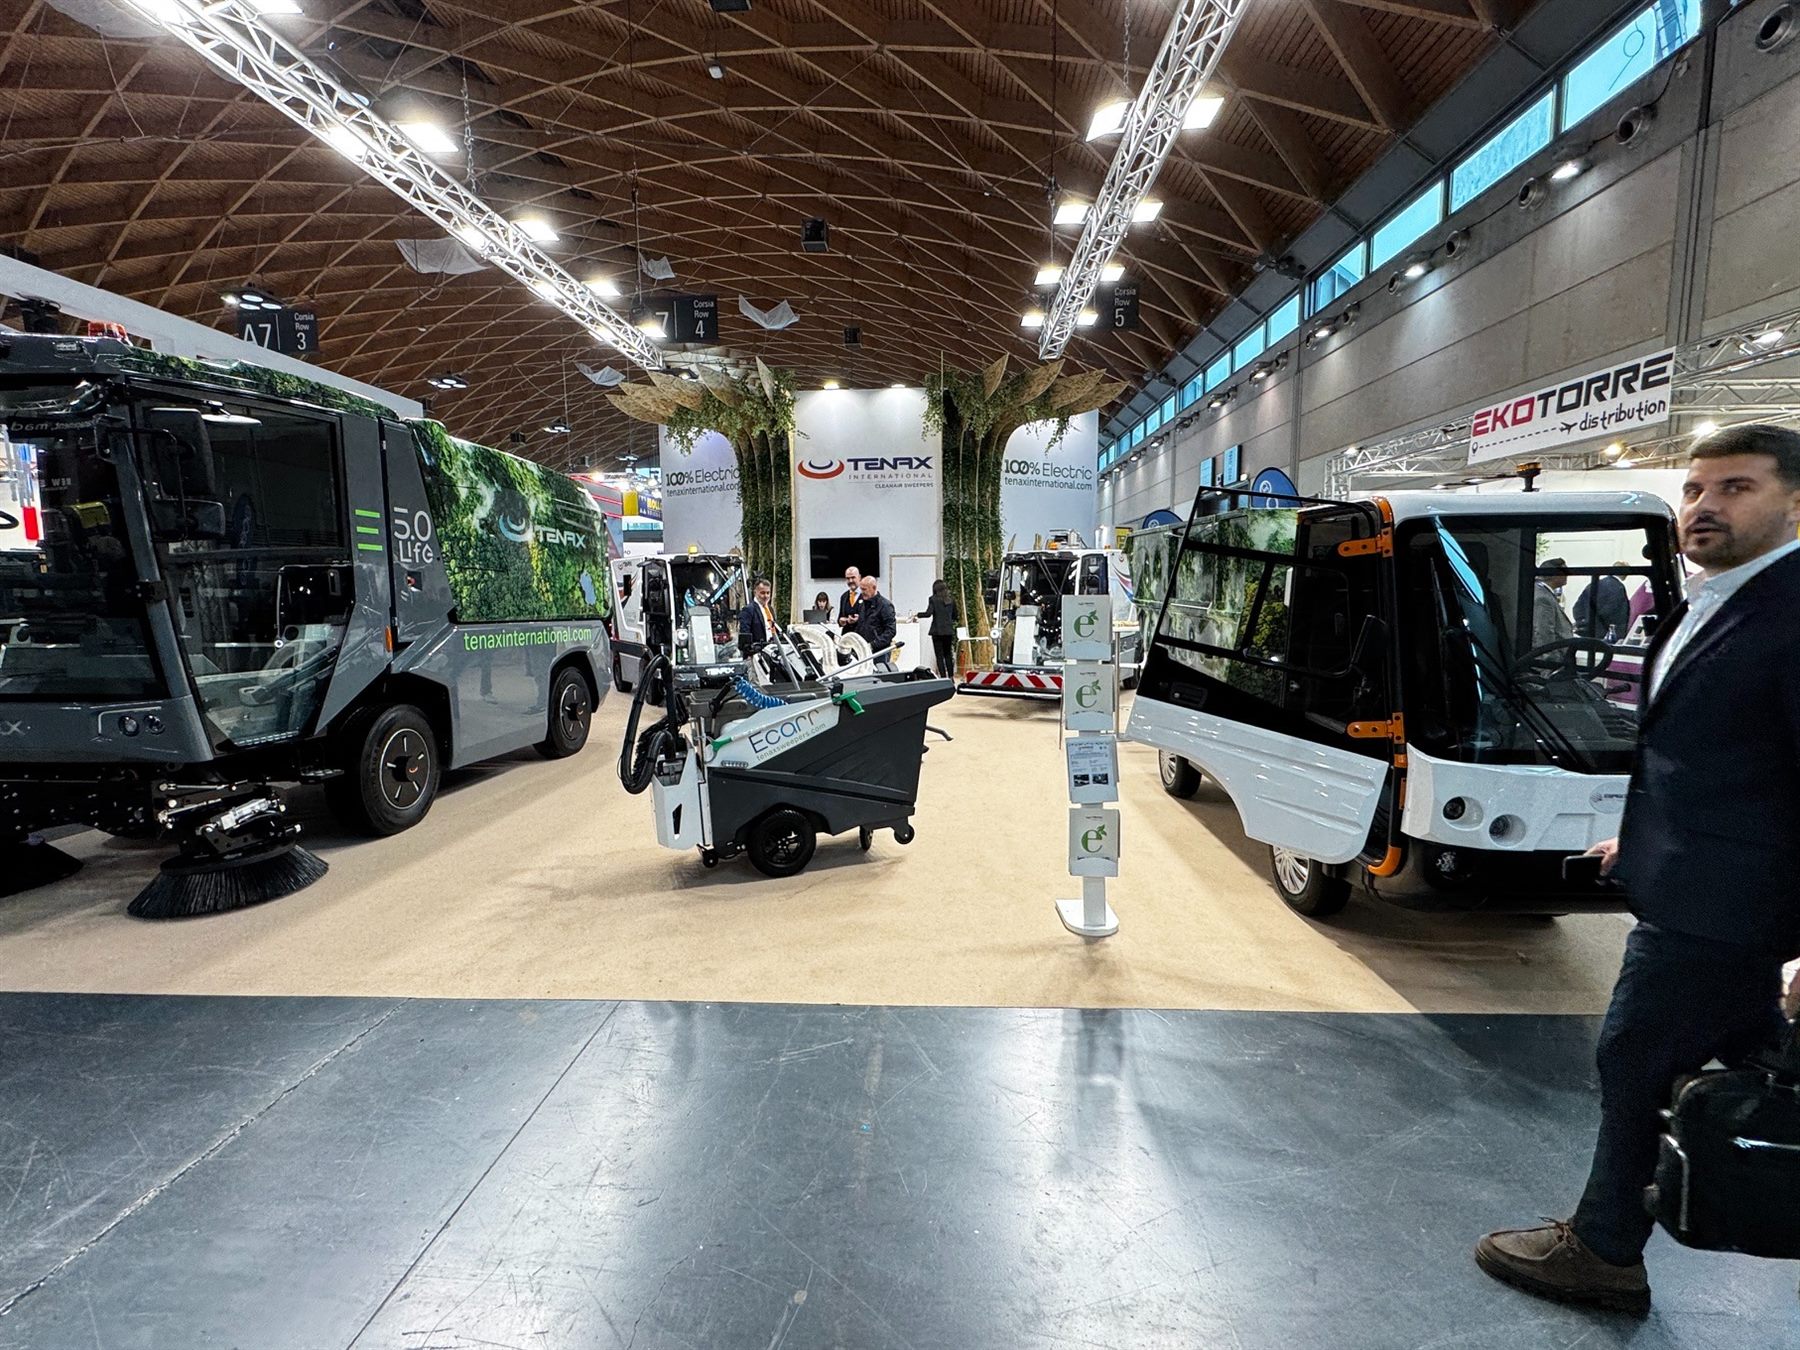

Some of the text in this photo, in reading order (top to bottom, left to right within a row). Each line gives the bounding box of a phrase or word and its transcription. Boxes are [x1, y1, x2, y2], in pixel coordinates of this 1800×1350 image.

[1114, 287, 1136, 296] Corsia
[693, 300, 714, 308] Corsia
[1114, 297, 1130, 306] Row
[294, 312, 315, 321] Corsia
[694, 310, 709, 318] Row
[1115, 308, 1125, 327] 5
[295, 322, 309, 330] Row
[695, 320, 705, 338] 4
[243, 323, 272, 349] A7
[296, 332, 306, 350] 3
[1472, 352, 1674, 437] EKOTORRE
[1579, 397, 1666, 432] distribution
[847, 456, 933, 471] TENAX
[1004, 459, 1092, 480] 100% Electric
[665, 470, 695, 487] 100%
[848, 472, 933, 480] INTERNATIONAL
[1004, 476, 1093, 491] tenaxinternational.com
[394, 506, 432, 542] 5.0
[534, 525, 587, 549] TENAX
[464, 627, 592, 651] tenaxinternational.com
[705, 667, 735, 676] TENAX
[748, 709, 820, 754] Ecarr
[757, 723, 826, 761] tenaxsweepers.com
